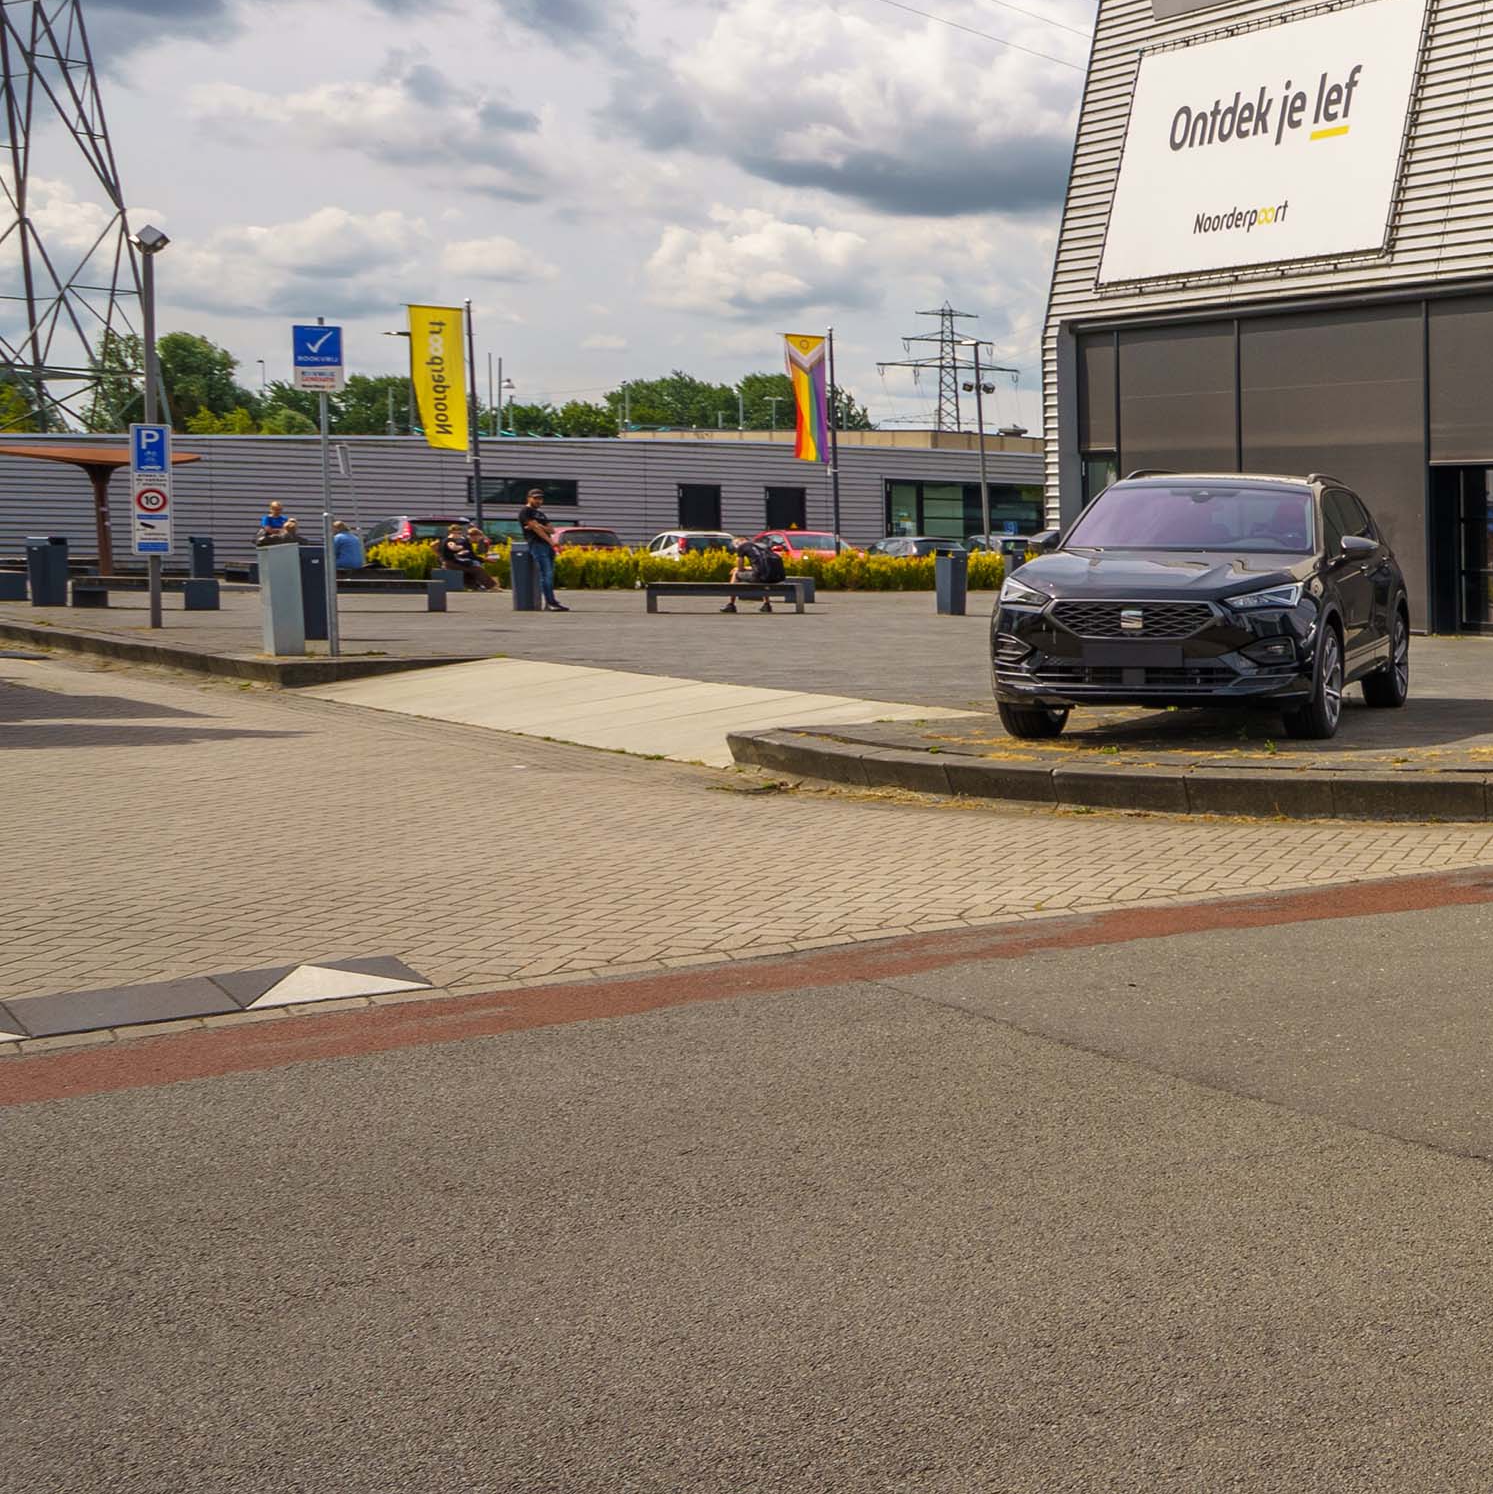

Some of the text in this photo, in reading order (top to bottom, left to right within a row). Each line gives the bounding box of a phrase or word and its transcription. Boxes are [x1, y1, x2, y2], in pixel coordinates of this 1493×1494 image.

[1169, 64, 1363, 151] Ontdek je lef
[1193, 200, 1289, 235] Noorderpoort
[141, 430, 160, 450] P
[144, 495, 160, 506] 10
